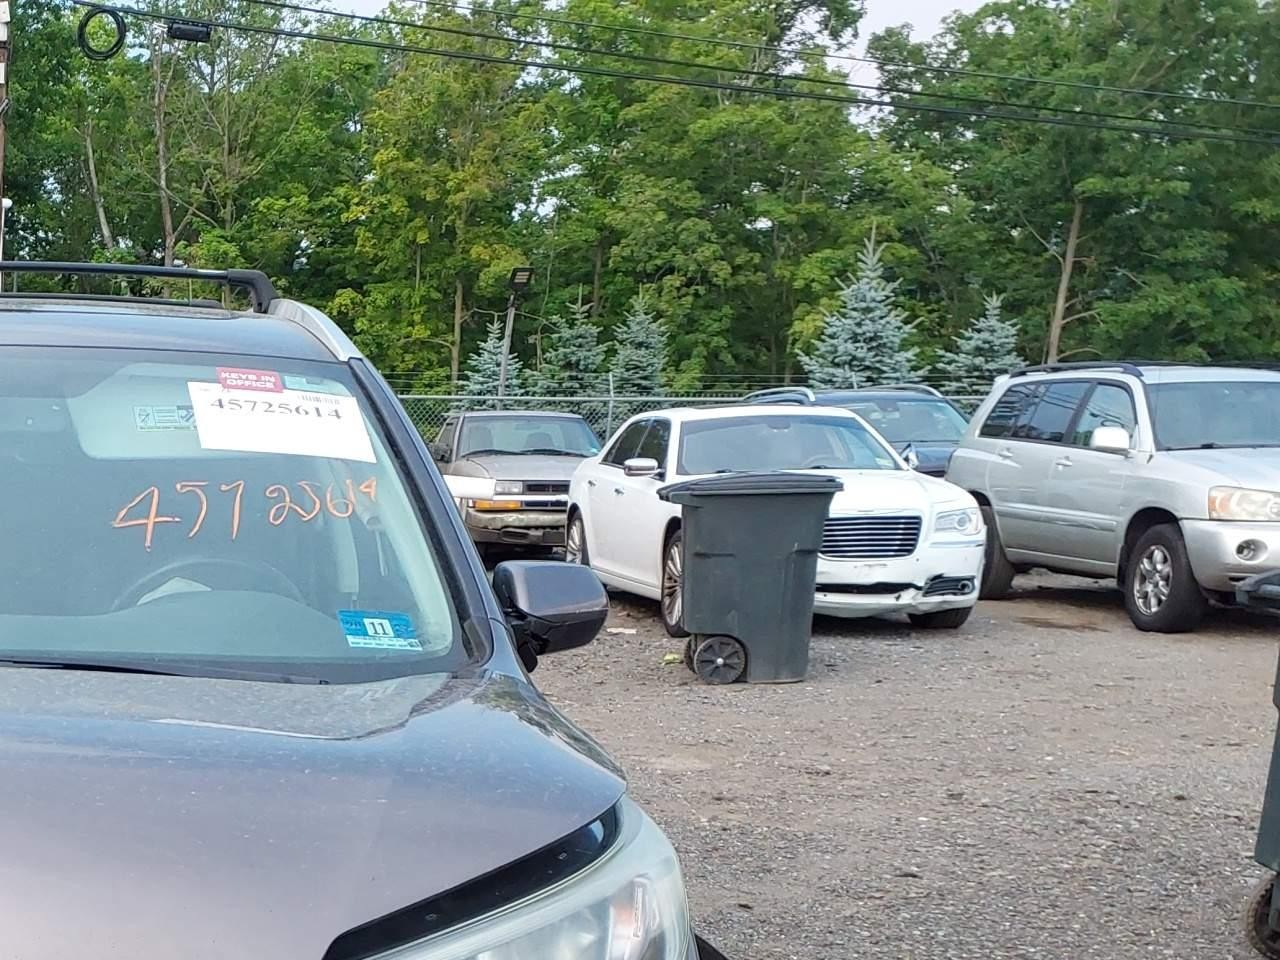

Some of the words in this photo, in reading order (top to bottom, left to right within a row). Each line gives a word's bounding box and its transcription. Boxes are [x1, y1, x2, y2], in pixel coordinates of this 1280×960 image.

[220, 371, 258, 381] KEYS
[260, 375, 275, 383] IN
[226, 379, 275, 388] OFFICE
[210, 398, 342, 420] 45725614
[369, 621, 390, 636] 11
